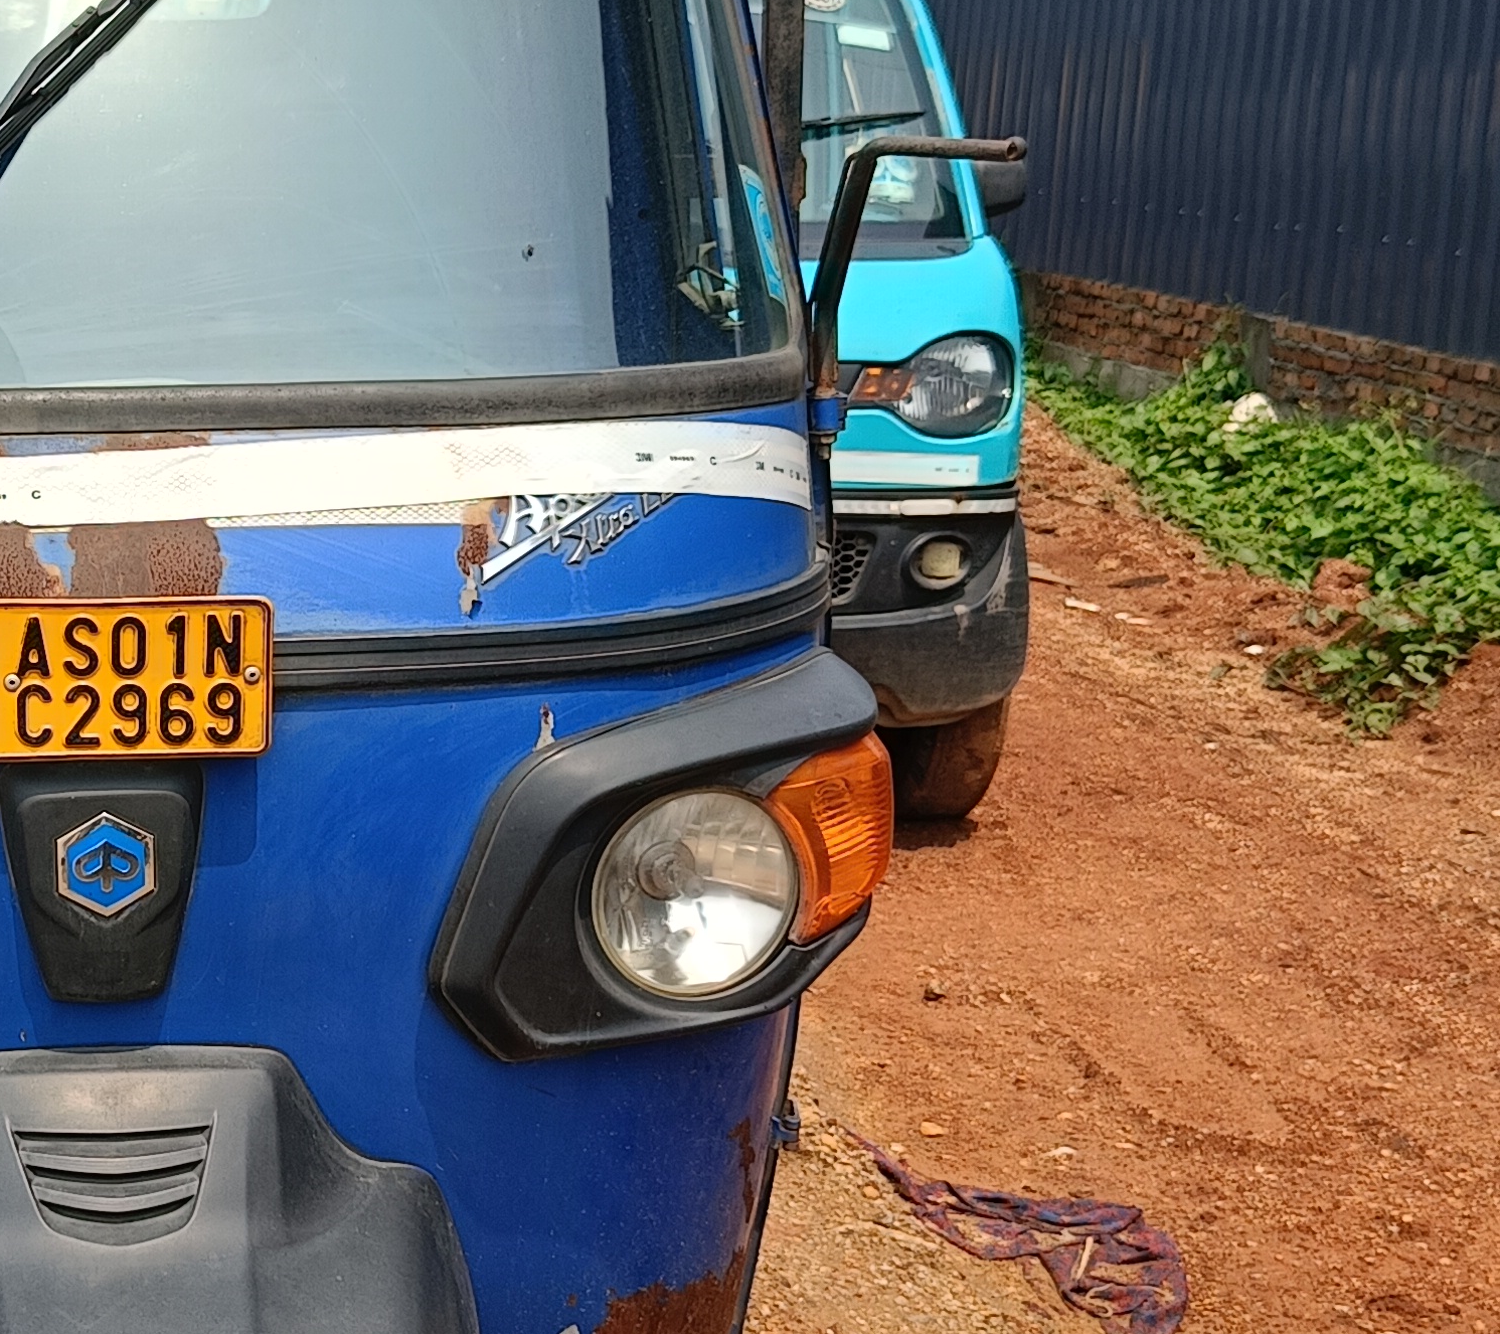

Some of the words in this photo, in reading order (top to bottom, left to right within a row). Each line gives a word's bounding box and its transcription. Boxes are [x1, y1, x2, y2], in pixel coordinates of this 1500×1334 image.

[709, 456, 718, 466] C
[31, 490, 42, 500] C
[17, 610, 245, 678] AS01N
[15, 683, 243, 748] C2969
